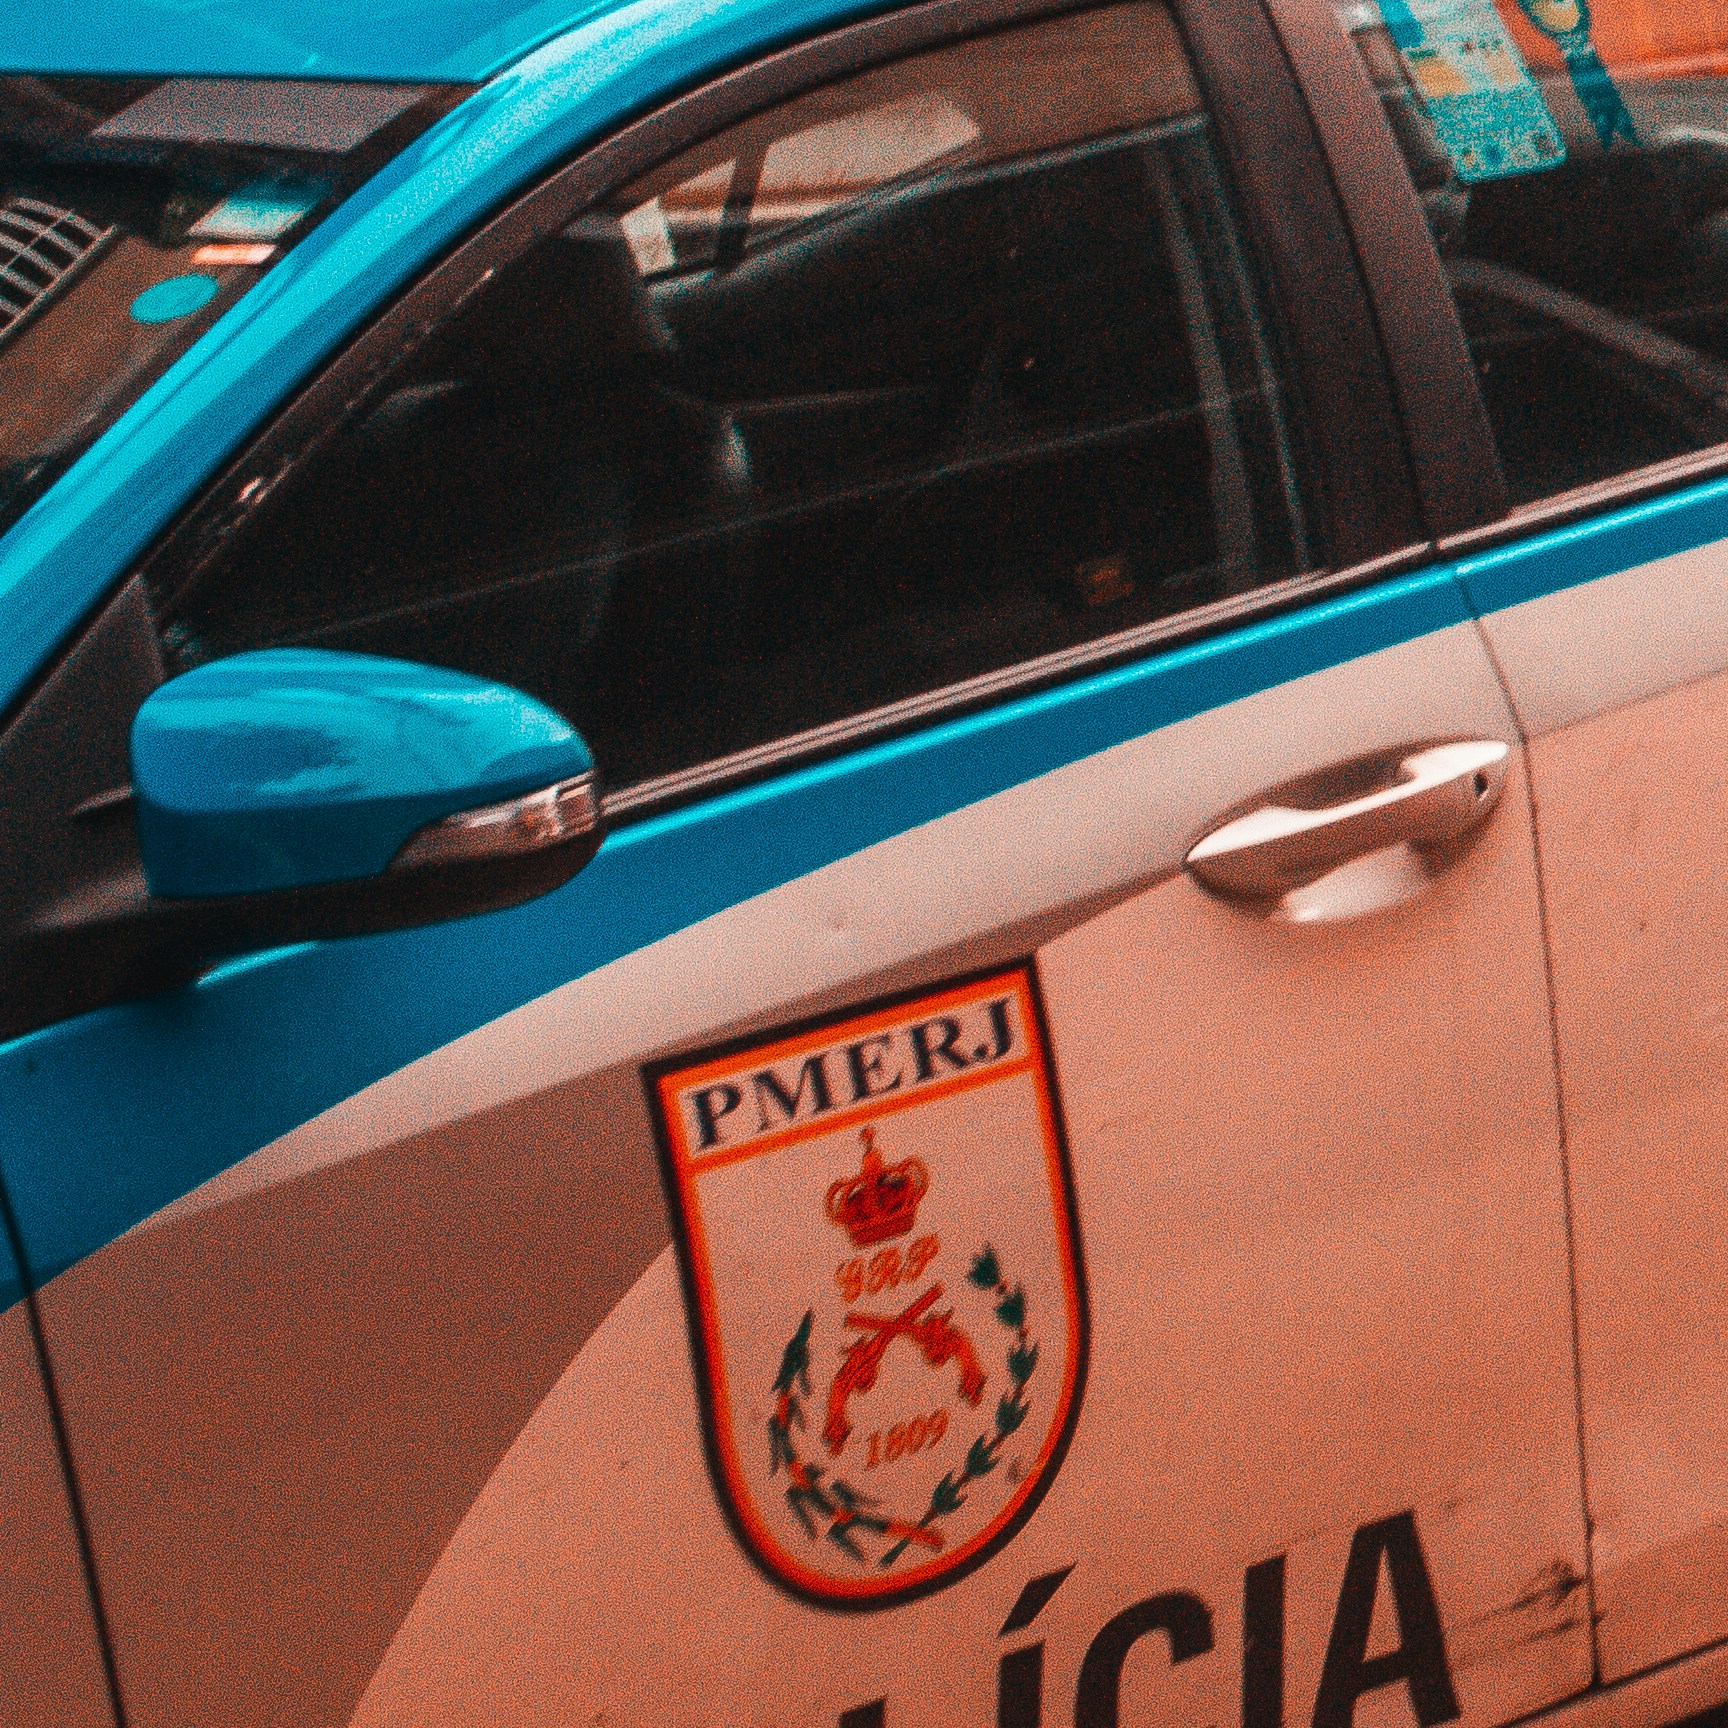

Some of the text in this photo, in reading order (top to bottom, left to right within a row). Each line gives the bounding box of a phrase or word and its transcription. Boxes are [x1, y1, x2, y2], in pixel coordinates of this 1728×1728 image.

[692, 998, 1018, 1152] PMERJ
[866, 1407, 950, 1469] 1809
[838, 1509, 1461, 1728] ÍCIA
